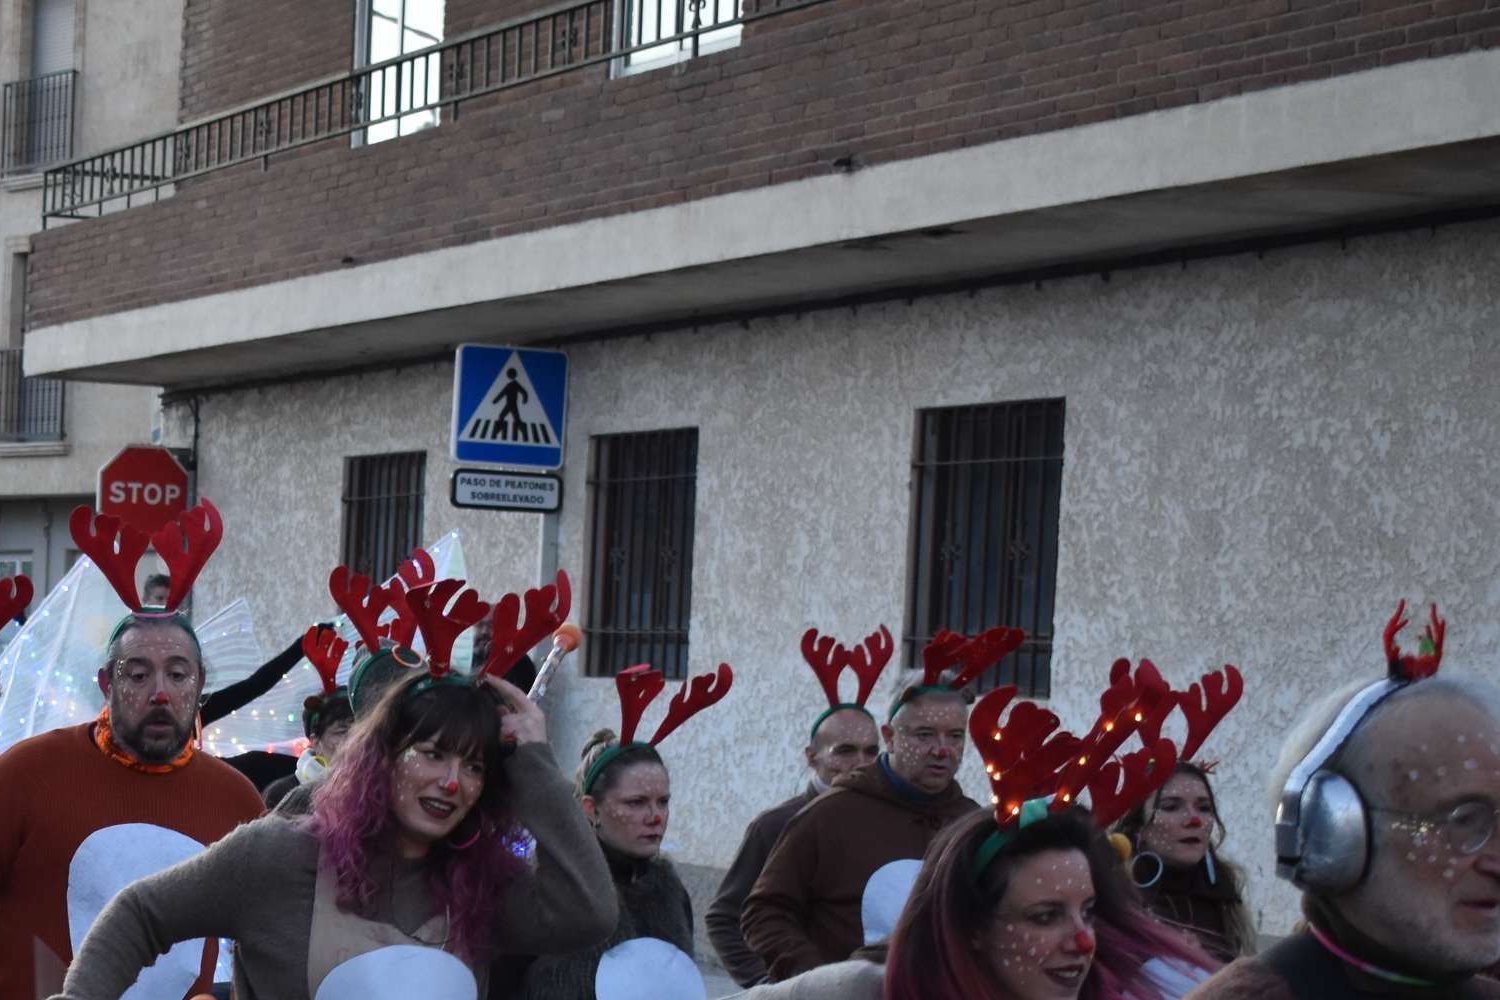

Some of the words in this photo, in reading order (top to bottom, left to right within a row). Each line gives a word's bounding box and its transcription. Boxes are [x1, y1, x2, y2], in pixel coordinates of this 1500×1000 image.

[460, 477, 486, 486] PASO
[489, 480, 501, 488] DE
[504, 481, 555, 492] PEATONES
[109, 480, 180, 506] STOP
[470, 491, 545, 504] SOBREELEVADO
